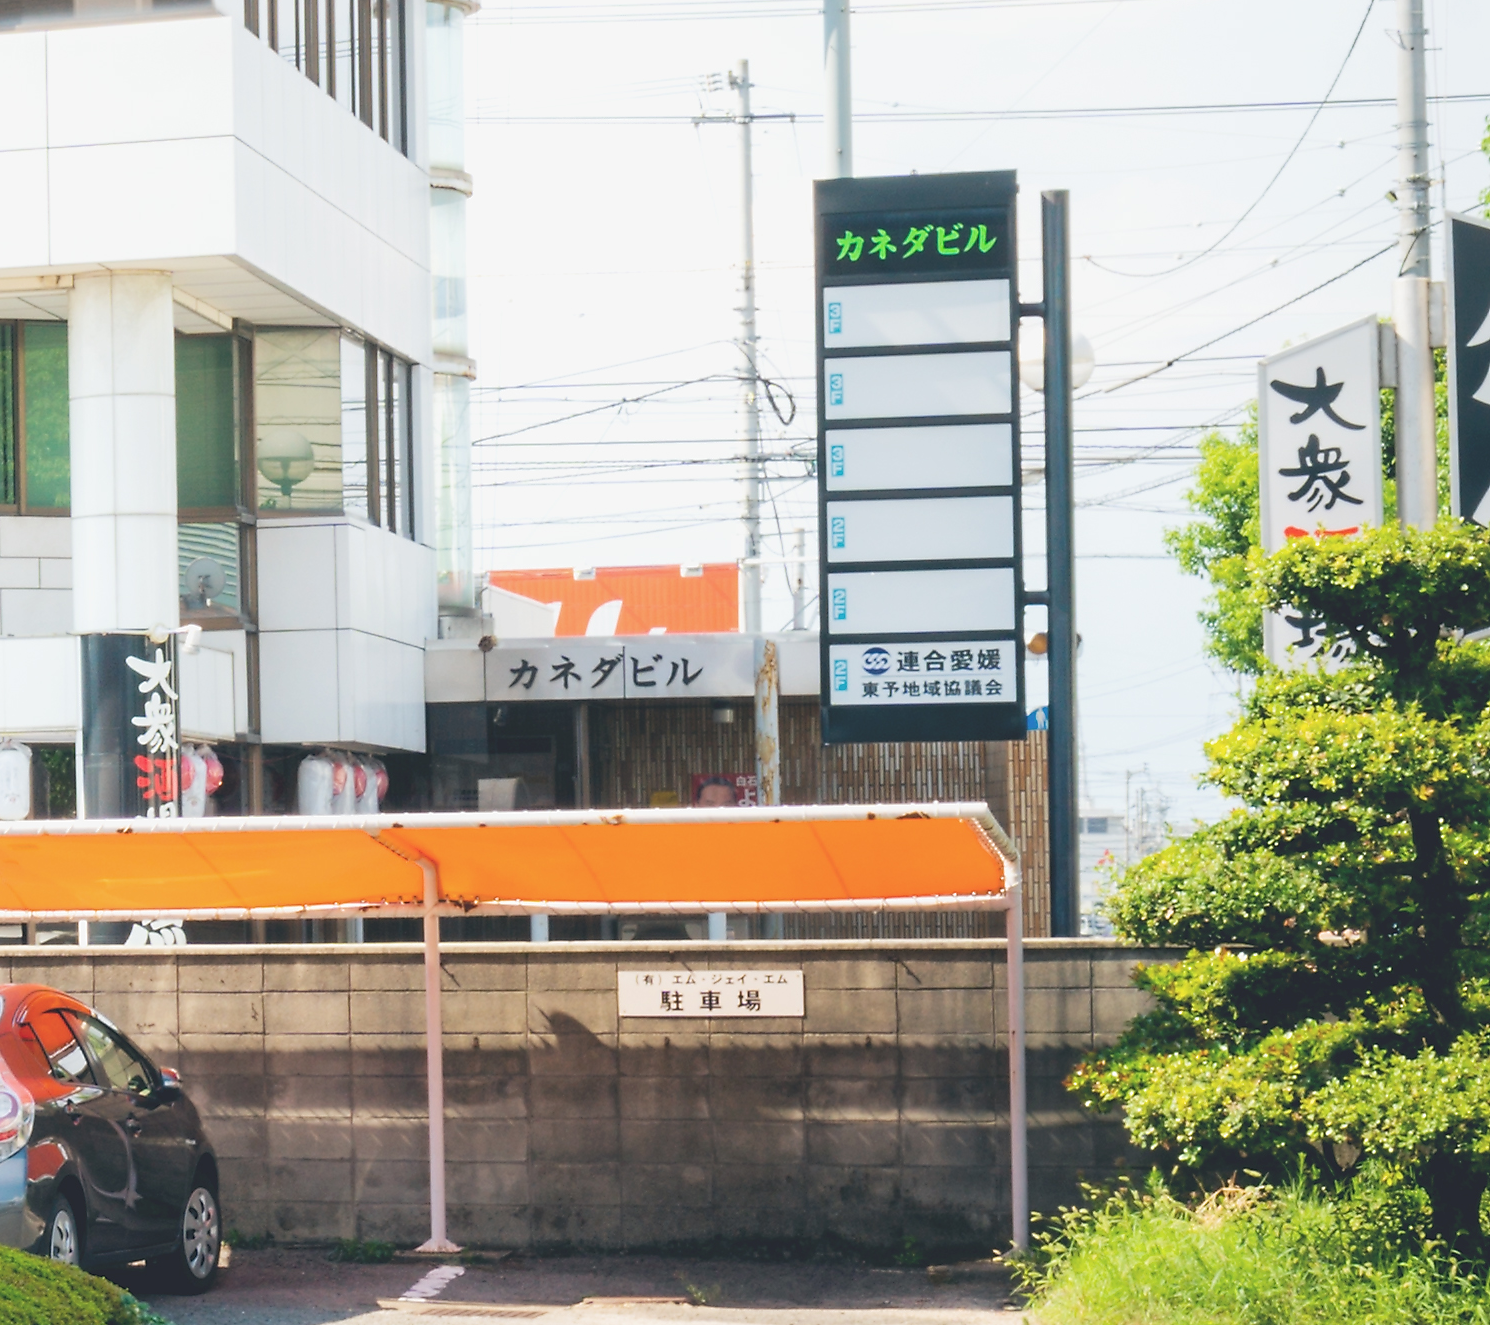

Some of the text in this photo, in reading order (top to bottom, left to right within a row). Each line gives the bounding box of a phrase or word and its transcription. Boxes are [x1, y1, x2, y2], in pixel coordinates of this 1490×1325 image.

[835, 221, 998, 262] カネダビル
[508, 652, 704, 690] カネダビル
[896, 648, 1001, 672] 連合愛媛
[861, 678, 1003, 698] 東予地域協議会
[660, 989, 762, 1012] 駐車場
